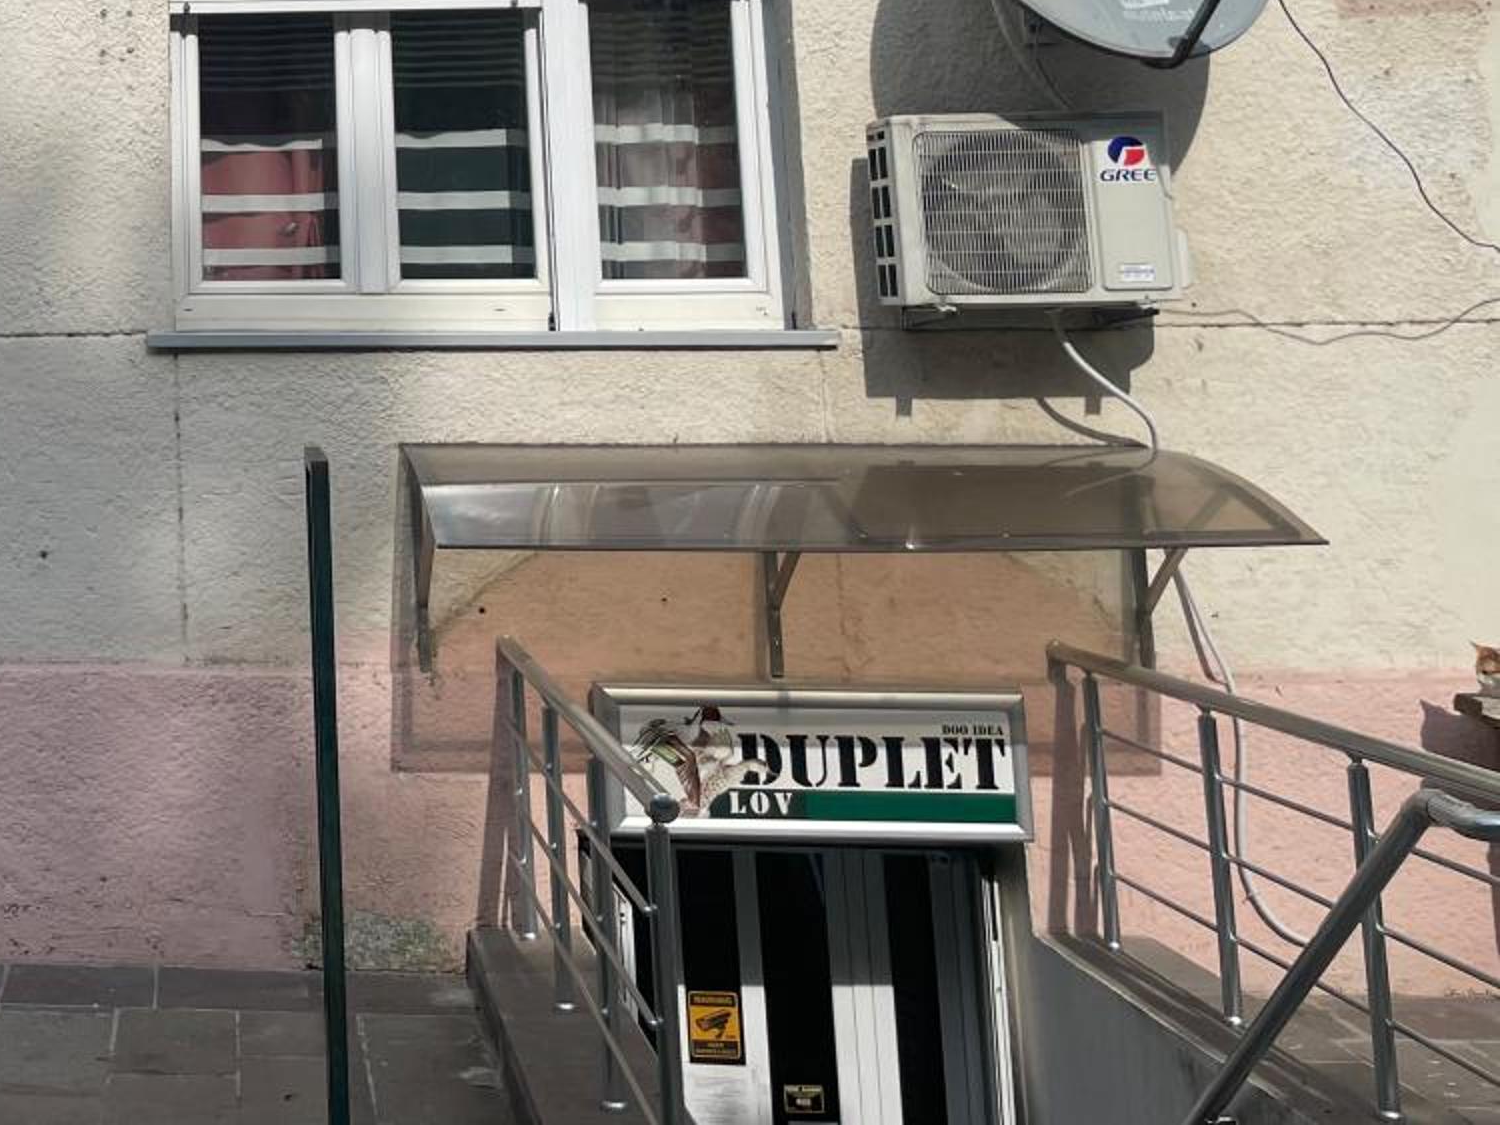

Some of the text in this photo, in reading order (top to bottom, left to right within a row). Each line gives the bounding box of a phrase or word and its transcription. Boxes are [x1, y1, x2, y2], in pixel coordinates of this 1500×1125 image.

[1100, 169, 1156, 181] GREE
[737, 732, 1005, 790] DUPLET
[728, 791, 793, 815] LOV
